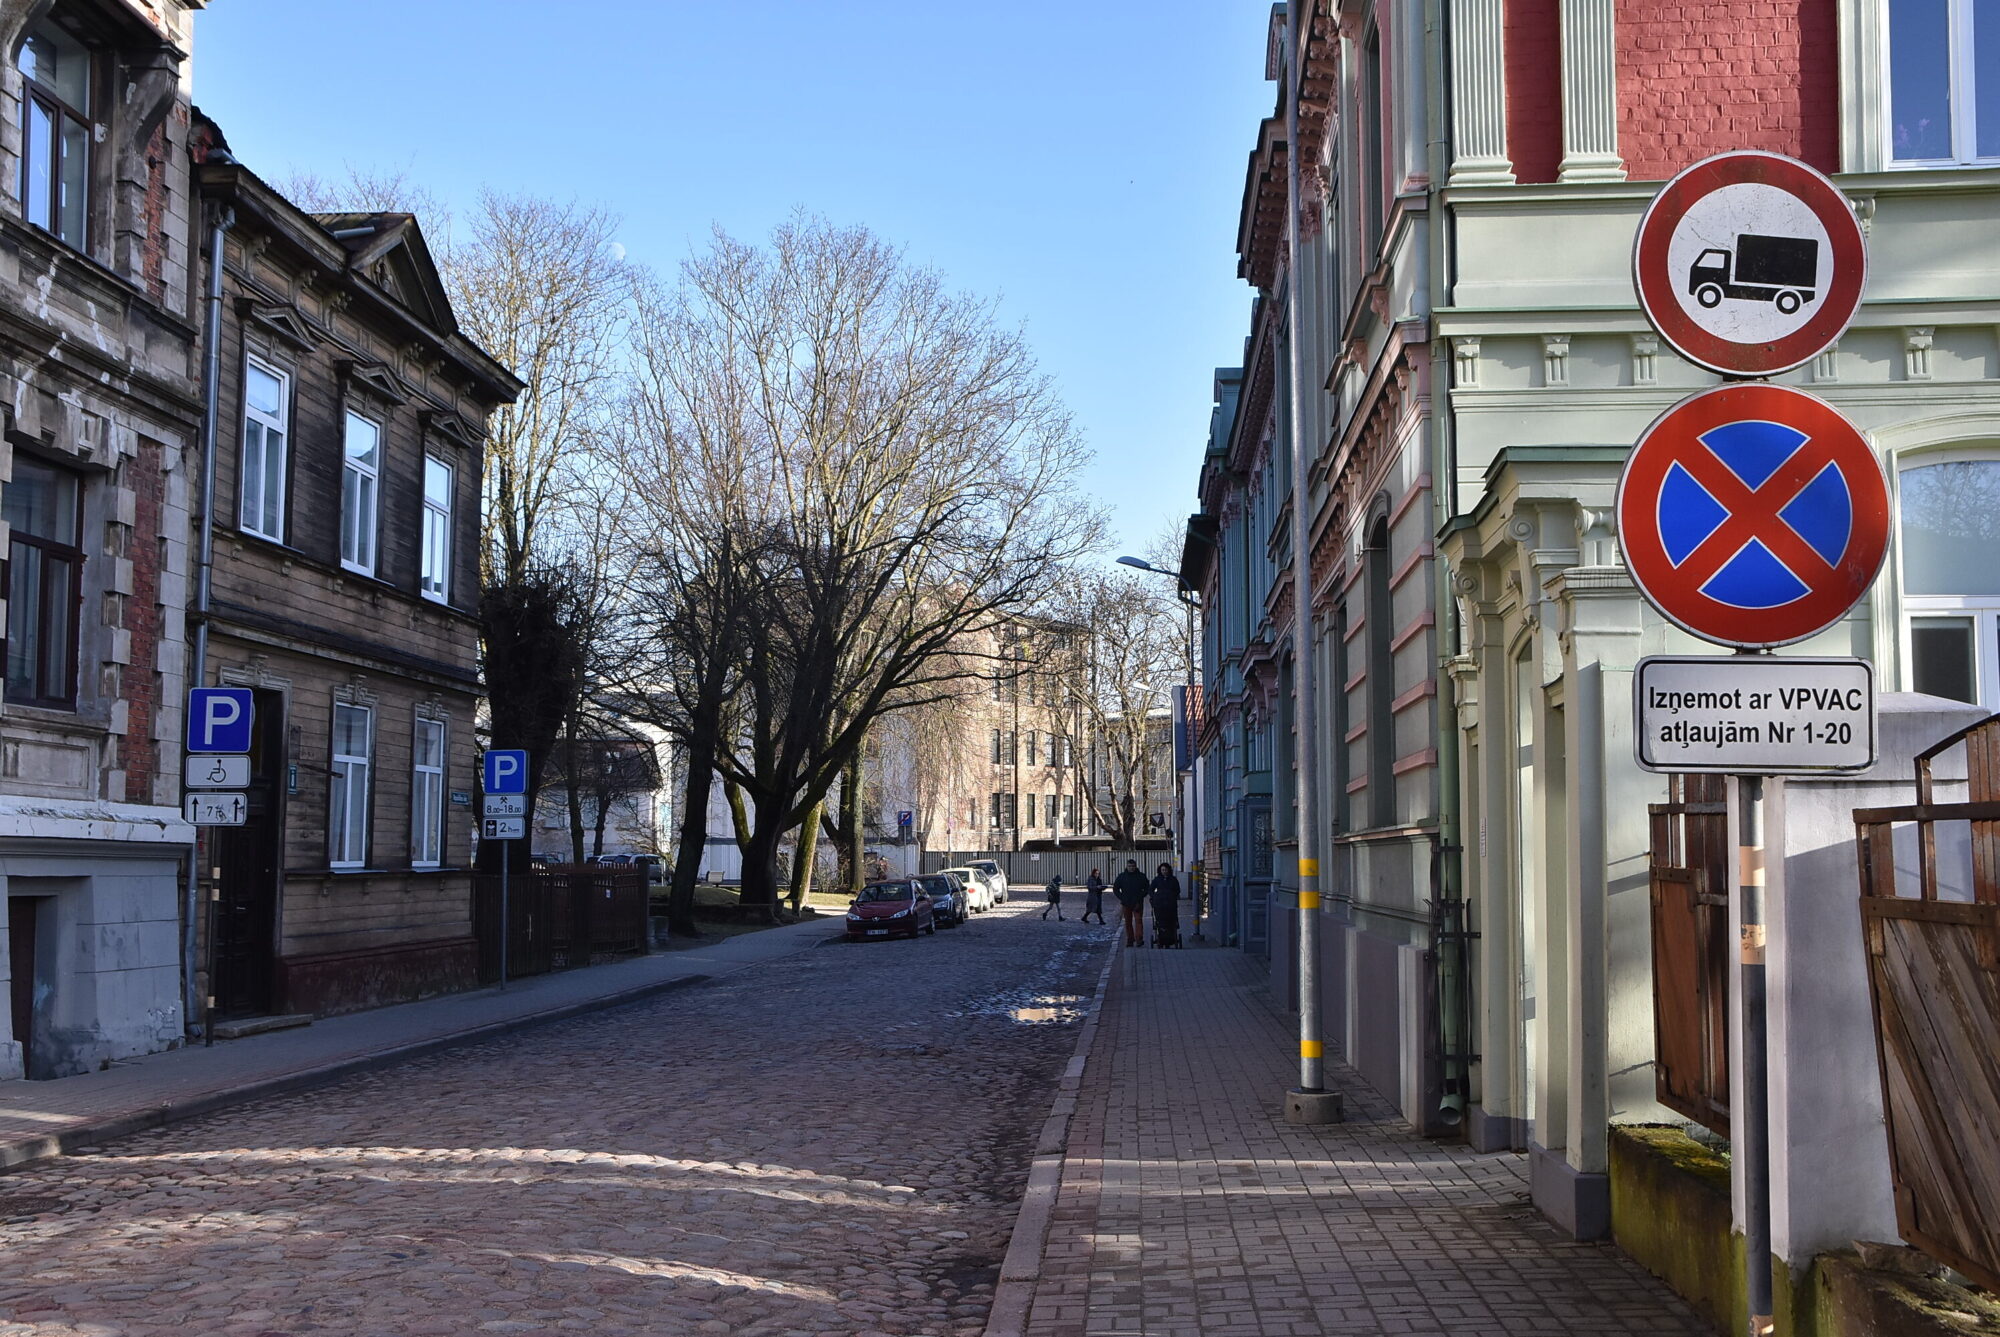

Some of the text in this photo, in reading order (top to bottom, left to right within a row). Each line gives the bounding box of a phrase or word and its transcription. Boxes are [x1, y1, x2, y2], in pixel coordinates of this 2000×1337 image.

[1649, 686, 1863, 714] Izņemot ar VPVAC
[204, 695, 241, 745] P
[1660, 720, 1852, 748] atļaujām Nr 1-20
[494, 755, 518, 790] P
[499, 821, 507, 833] 2
